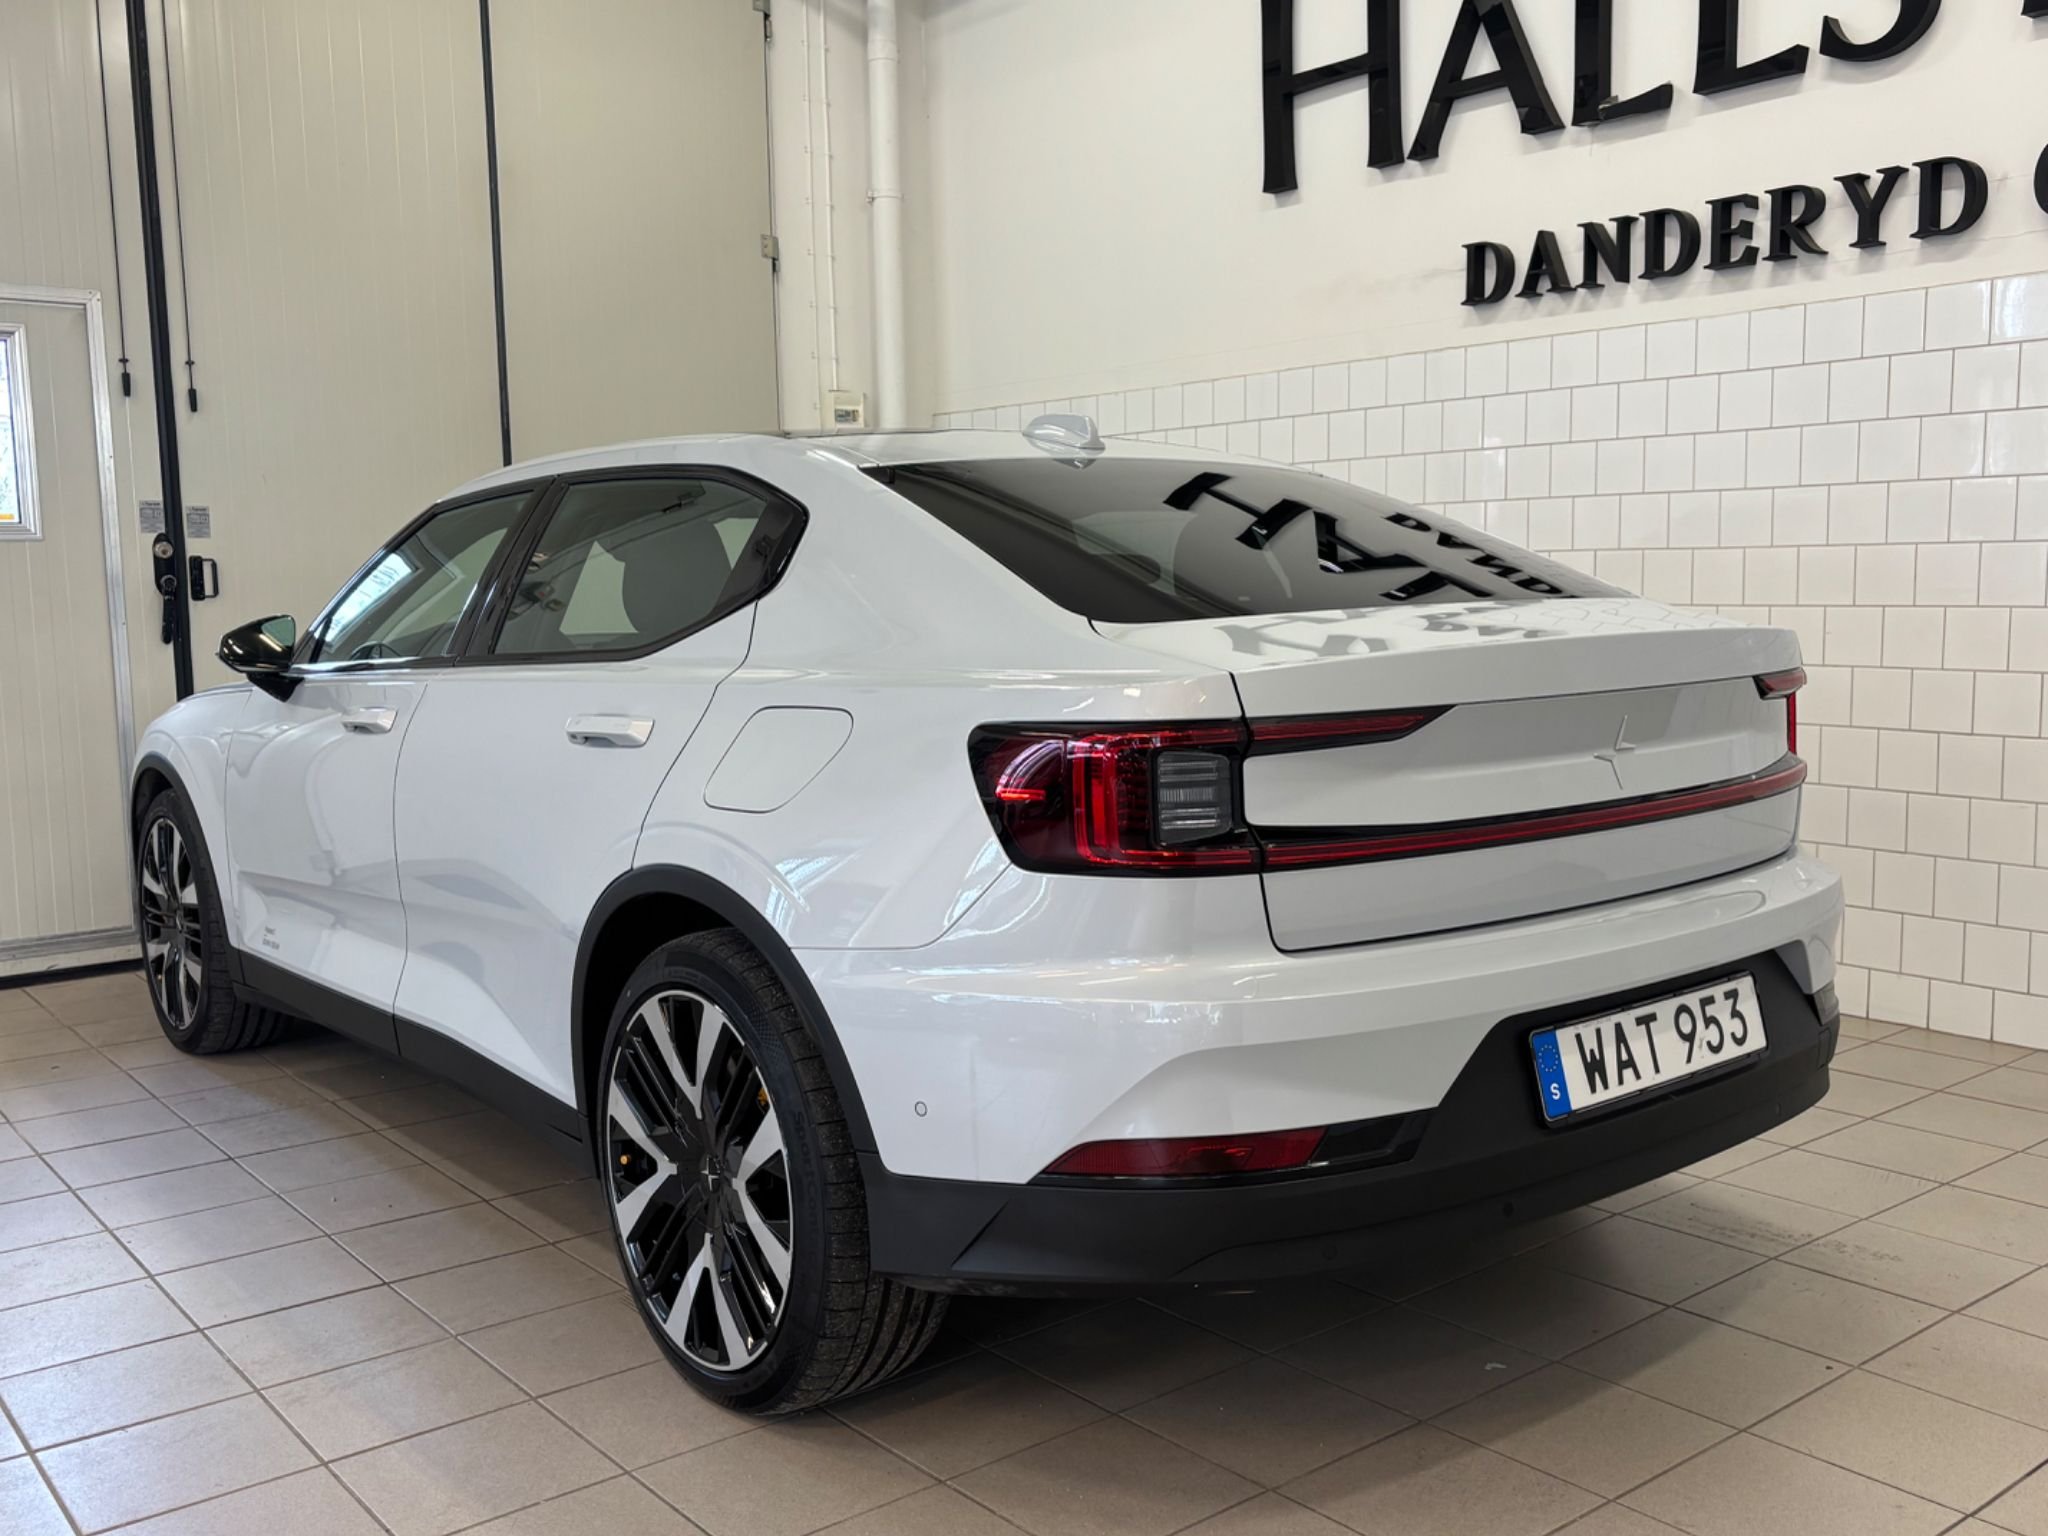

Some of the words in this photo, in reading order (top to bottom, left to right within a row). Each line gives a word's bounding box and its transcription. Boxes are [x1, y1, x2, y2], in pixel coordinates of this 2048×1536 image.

[1262, 0, 1942, 194] HALL
[1461, 156, 1989, 306] DANDERYD
[1550, 1083, 1561, 1100] S
[1575, 1012, 1660, 1095] WAT
[1674, 988, 1748, 1064] 953
